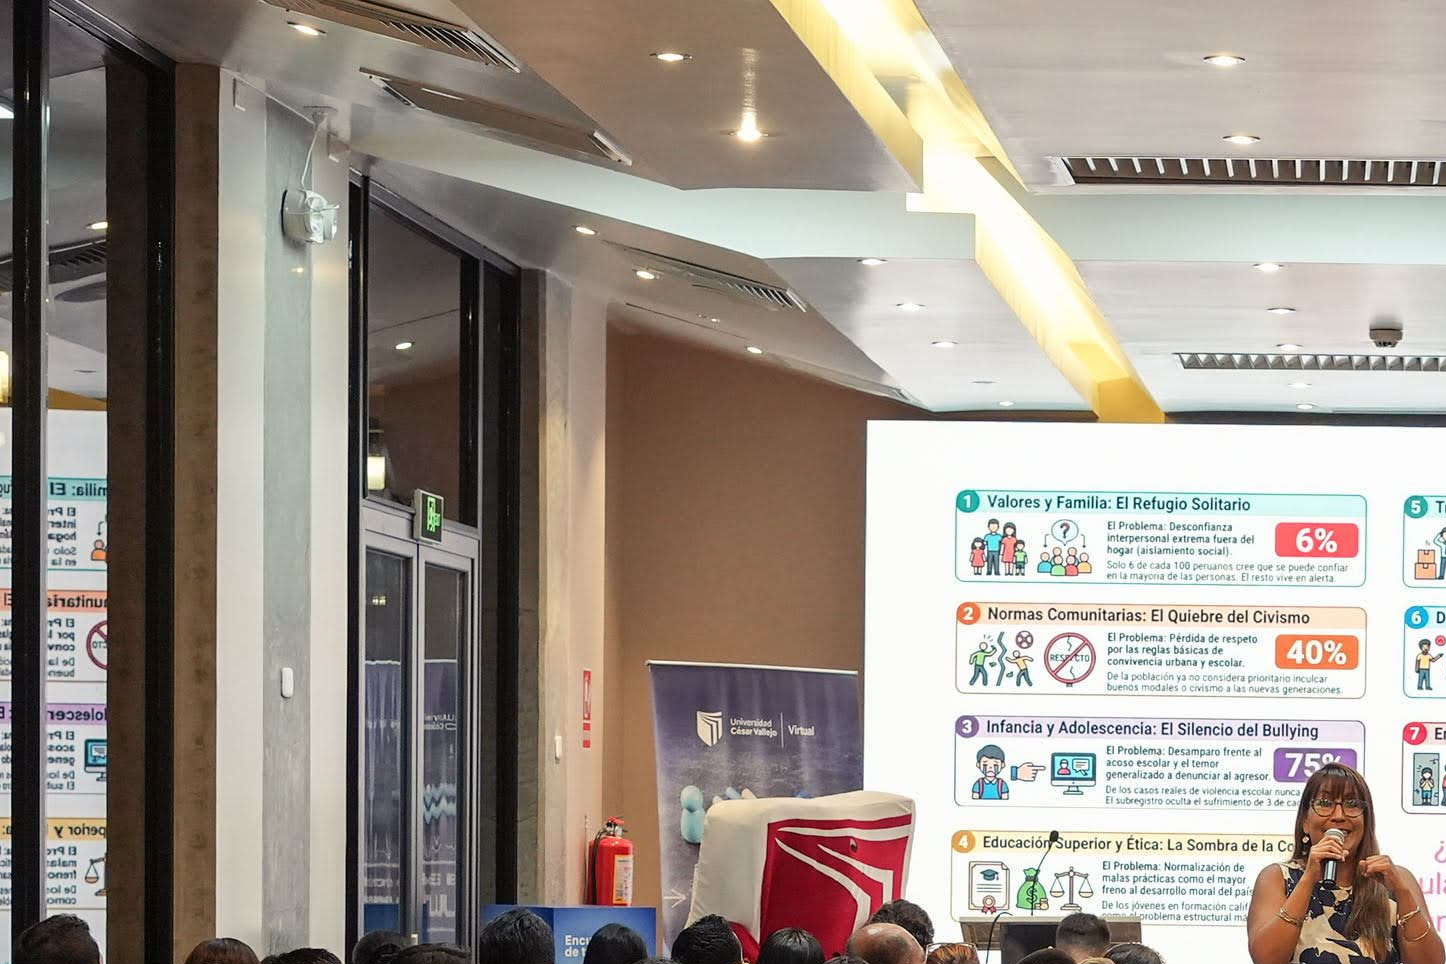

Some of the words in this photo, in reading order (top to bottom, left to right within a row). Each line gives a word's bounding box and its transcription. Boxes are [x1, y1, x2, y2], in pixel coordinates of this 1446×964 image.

[964, 495, 972, 508] 1
[987, 494, 1040, 508] Valores
[1044, 498, 1052, 512] y
[1056, 495, 1111, 509] Familia:
[1116, 495, 1128, 509] El
[1133, 495, 1187, 513] Refugio
[1191, 496, 1250, 511] Solitario
[1411, 501, 1421, 514] 5
[1107, 520, 1115, 530] El
[1118, 520, 1165, 530] Problema:
[1169, 521, 1232, 531] Desconfianza
[1107, 533, 1169, 544] interpersonal
[1172, 534, 1210, 543] extrema
[1213, 534, 1237, 543] fuera
[1240, 534, 1254, 544] del
[1296, 528, 1338, 552] 6%
[1106, 544, 1133, 556] hogar
[1136, 545, 1195, 556] (aislamiento
[1197, 546, 1231, 557] social).
[1106, 560, 1126, 569] Solo
[1128, 560, 1134, 569] 6
[1136, 560, 1147, 569] de
[1149, 560, 1172, 572] cada
[1174, 561, 1190, 572] 100
[1192, 562, 1233, 572] peruanos
[1235, 563, 1254, 573] cree
[1256, 563, 1273, 572] que
[1288, 562, 1315, 573] puede
[1317, 562, 1348, 572] confiar
[964, 608, 974, 620] 2
[988, 606, 1043, 620] Normas
[1047, 607, 1146, 622] Comunitarias:
[1151, 608, 1163, 622] El
[1167, 608, 1223, 624] Quiebre
[1227, 609, 1248, 623] del
[1253, 610, 1310, 624] Civismo
[1412, 612, 1422, 624] 6
[1107, 632, 1116, 642] El
[1119, 632, 1166, 642] Problema:
[1169, 632, 1205, 643] Pérdida
[1208, 633, 1219, 643] de
[1222, 634, 1257, 645] respeto
[1287, 641, 1347, 664] 40%
[730, 718, 772, 726] Universidad
[754, 728, 778, 738] Vallejo
[788, 725, 814, 736] Virtual
[962, 720, 972, 733] 3
[986, 719, 1042, 733] Infancia
[1046, 723, 1054, 737] y
[1058, 720, 1156, 735] Adolescencia:
[1161, 721, 1172, 735] El
[1177, 721, 1233, 736] Silencio
[1237, 722, 1258, 736] del
[1262, 722, 1318, 740] Bullying
[1410, 727, 1420, 740] 7
[1106, 745, 1114, 755] El
[1117, 745, 1164, 755] Problema:
[1168, 746, 1220, 757] Desamparo
[1223, 746, 1251, 756] frente
[1253, 747, 1262, 756] al
[958, 835, 968, 848] 4
[983, 836, 1050, 848] Educación
[1055, 836, 1111, 852] Superior
[1115, 840, 1122, 853] y
[1126, 835, 1163, 850] Ética:
[1167, 838, 1182, 850] La
[1186, 838, 1237, 851] Sombra
[1241, 839, 1258, 851] de
[1262, 839, 1273, 852] la
[1102, 860, 1110, 870] El
[1113, 860, 1160, 874] Problema:
[1164, 861, 1230, 875] Normalización
[1233, 862, 1244, 872] de
[565, 935, 592, 946] Encu
[565, 946, 578, 957] de
